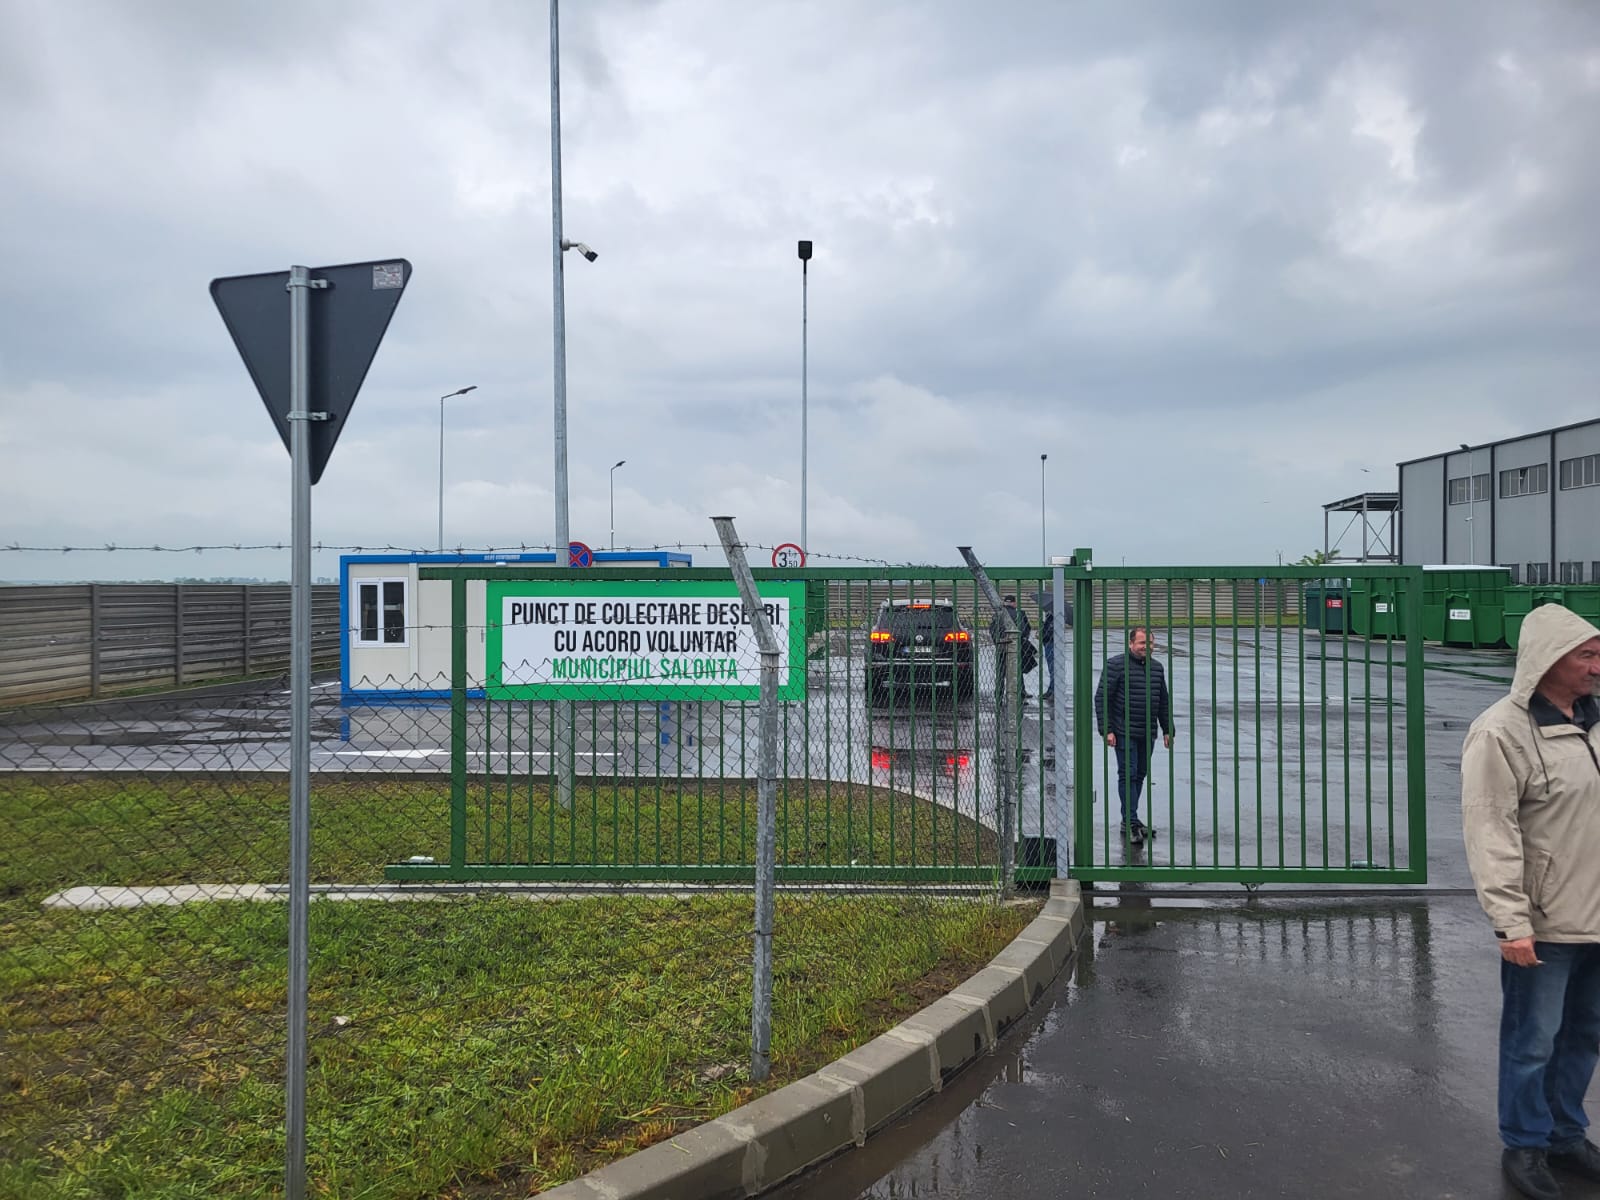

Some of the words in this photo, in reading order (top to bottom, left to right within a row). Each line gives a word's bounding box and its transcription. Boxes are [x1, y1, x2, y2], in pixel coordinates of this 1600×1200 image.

[511, 602, 569, 625] PUNCT
[574, 602, 596, 625] DE
[602, 602, 701, 625] COLECTARE
[707, 603, 780, 629] DEȘERI
[554, 630, 577, 652] CU
[582, 630, 641, 652] ACORD
[649, 630, 737, 652] VOLUNTAR
[552, 658, 652, 679] MUNICIPIUL
[660, 658, 738, 680] SALONTA
